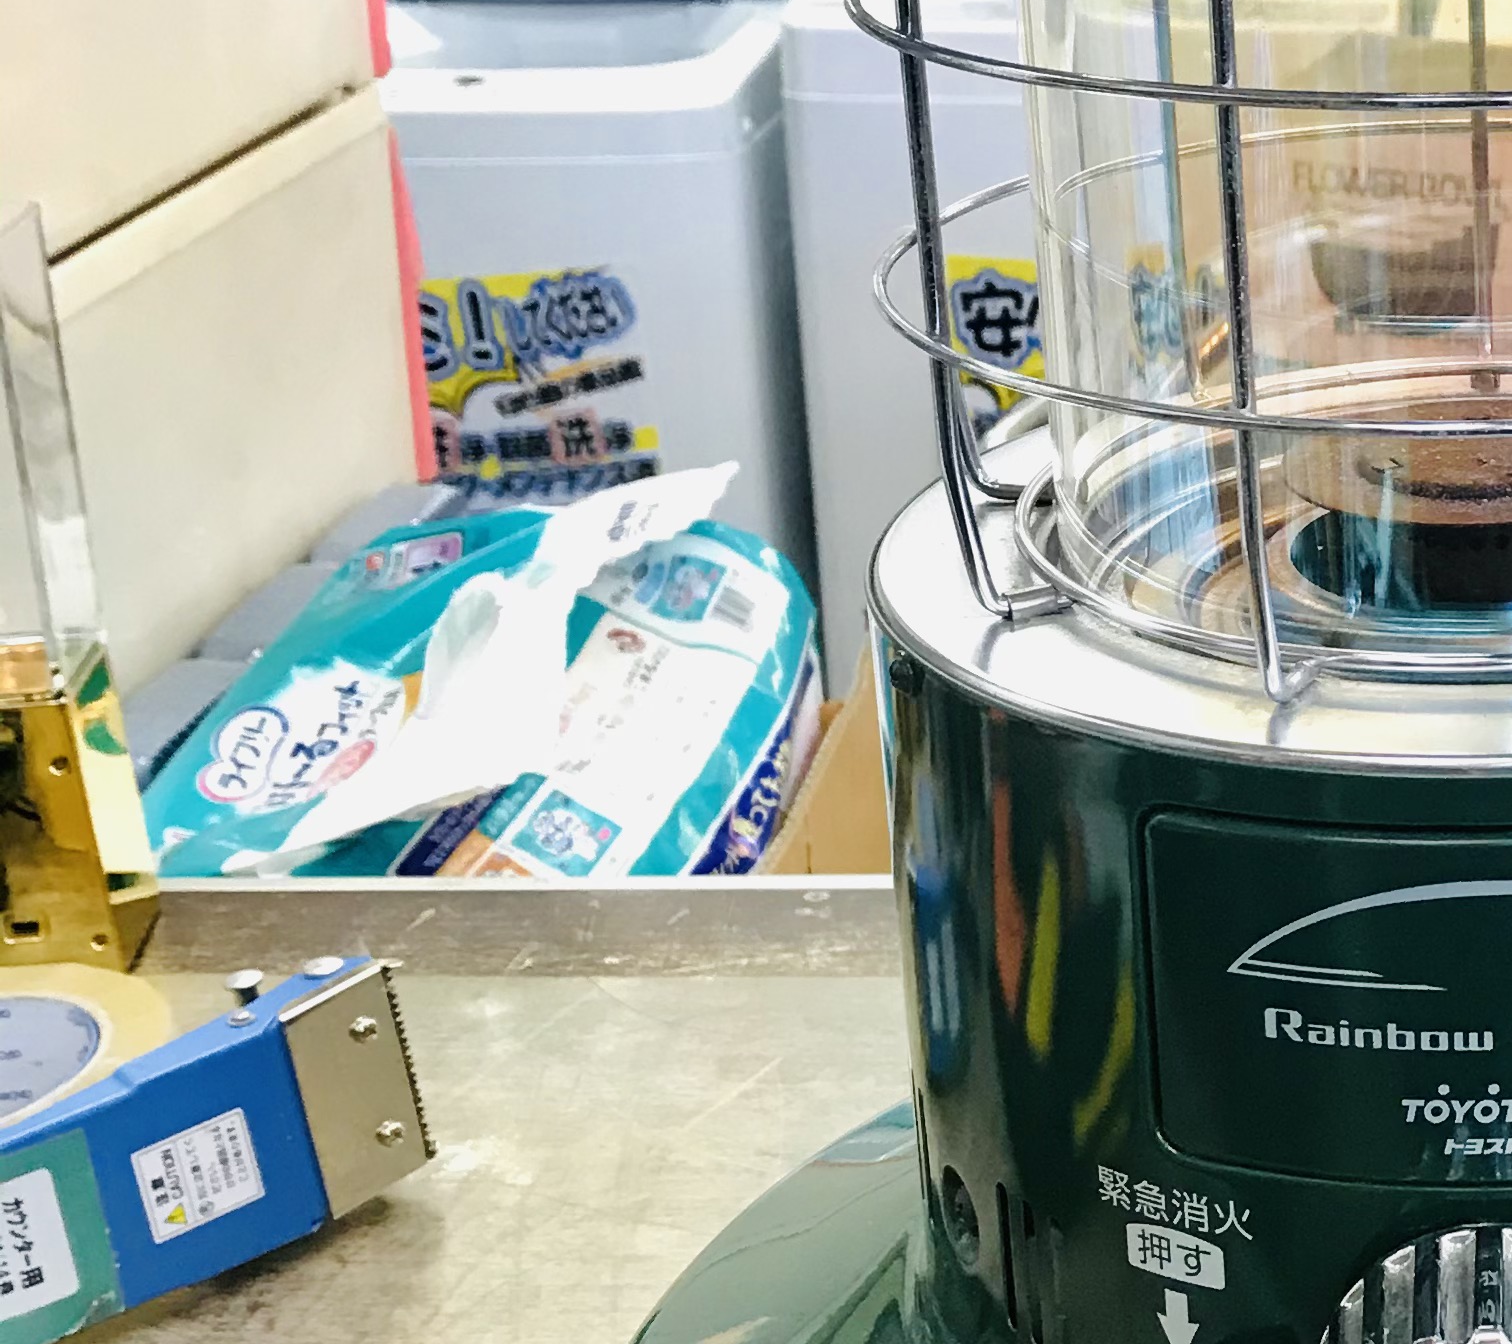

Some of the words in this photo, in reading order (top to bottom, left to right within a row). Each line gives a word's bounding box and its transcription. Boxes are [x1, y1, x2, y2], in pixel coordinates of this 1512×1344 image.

[1263, 1007, 1494, 1052] Rainbow
[160, 1148, 185, 1200] CAUTION
[1096, 1166, 1254, 1242] 緊急消火
[2, 1197, 45, 1290] カウンター用
[1135, 1230, 1213, 1278] 押す
